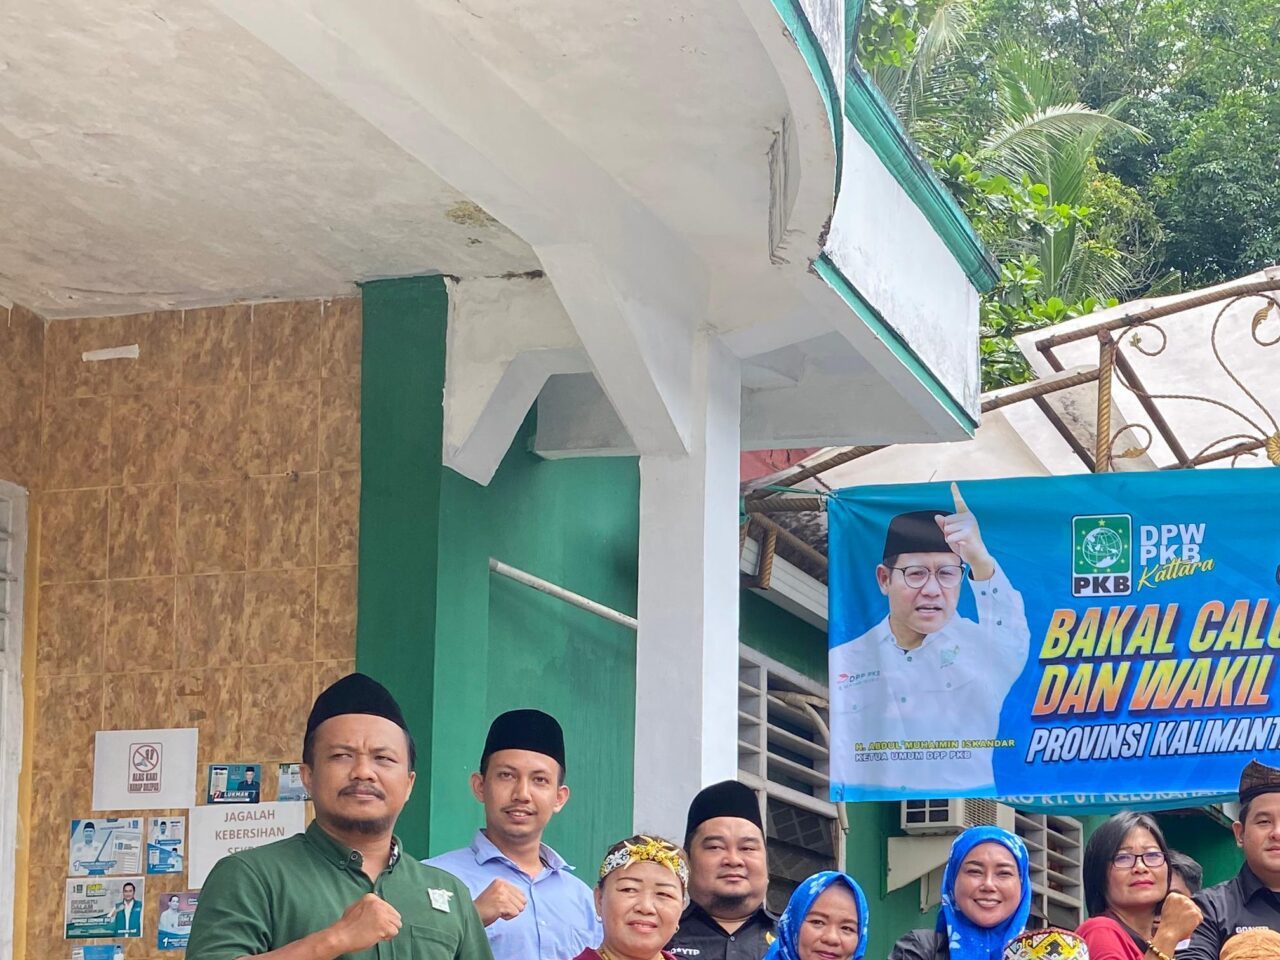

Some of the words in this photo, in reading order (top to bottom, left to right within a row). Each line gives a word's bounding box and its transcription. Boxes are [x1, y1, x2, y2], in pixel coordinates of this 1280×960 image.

[1140, 523, 1206, 546] DPW
[1140, 544, 1201, 566] PKB
[1073, 575, 1131, 595] PKB
[1039, 603, 1179, 659] BAKAL
[1031, 661, 1131, 716] DAN
[1128, 654, 1275, 711] WAKIL
[962, 739, 1015, 748] ISKANDAR
[1025, 721, 1151, 765] PROVINSI
[855, 753, 888, 762] KETUA
[891, 752, 924, 760] UMUM
[926, 752, 947, 760] DPP
[950, 751, 971, 759] PKB
[224, 810, 275, 822] JAGALAH
[215, 827, 285, 840] KEBERSIHAN
